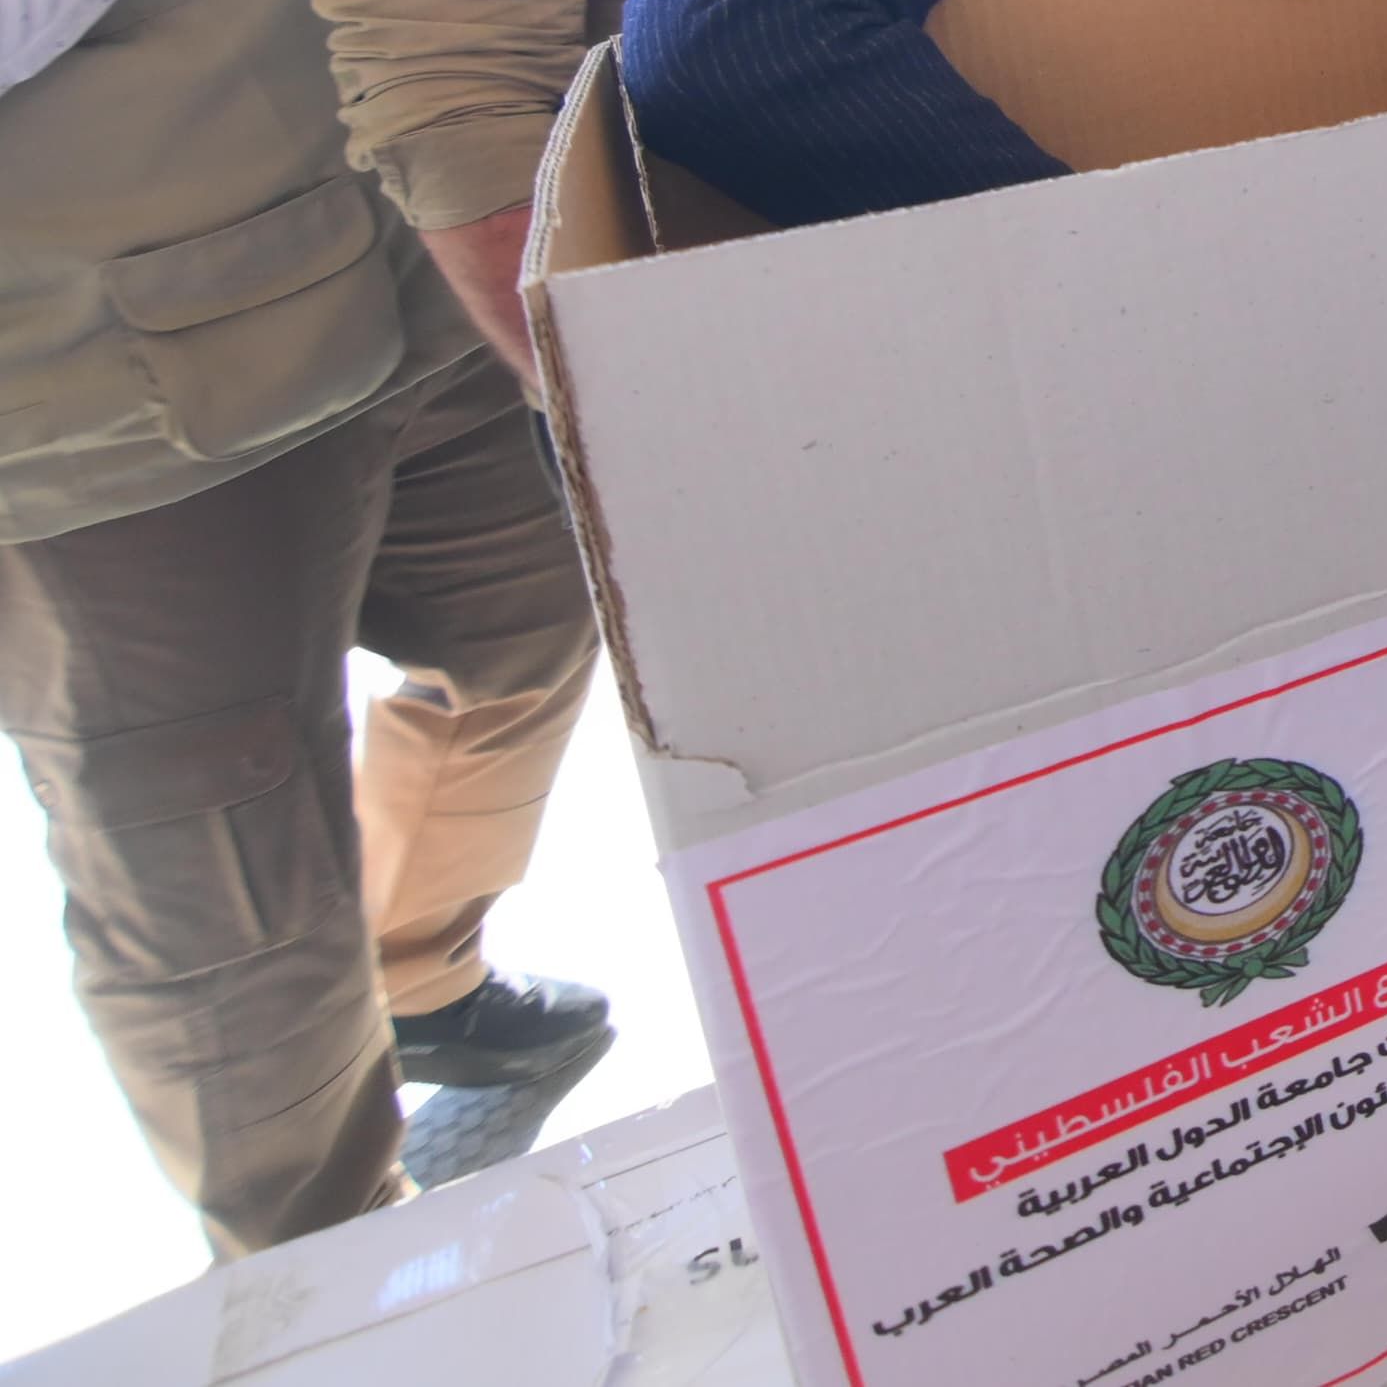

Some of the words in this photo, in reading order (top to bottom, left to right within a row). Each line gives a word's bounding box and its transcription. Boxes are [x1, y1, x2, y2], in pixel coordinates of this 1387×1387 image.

[1220, 986, 1364, 1070] الشعب
[1256, 1051, 1373, 1110] جامعة
[968, 1052, 1213, 1192] الفلسطيني
[1148, 1111, 1325, 1207] الإجتماعية
[1155, 1097, 1252, 1162] الدول
[1017, 1143, 1149, 1218] العربية
[998, 1204, 1145, 1278] والصحة
[1267, 1246, 1342, 1296] الهلال
[871, 1264, 994, 1338] العرب
[1161, 1285, 1261, 1350] الأحمر
[1177, 1338, 1227, 1371] RED
[1230, 1274, 1349, 1344] CRESCENT
